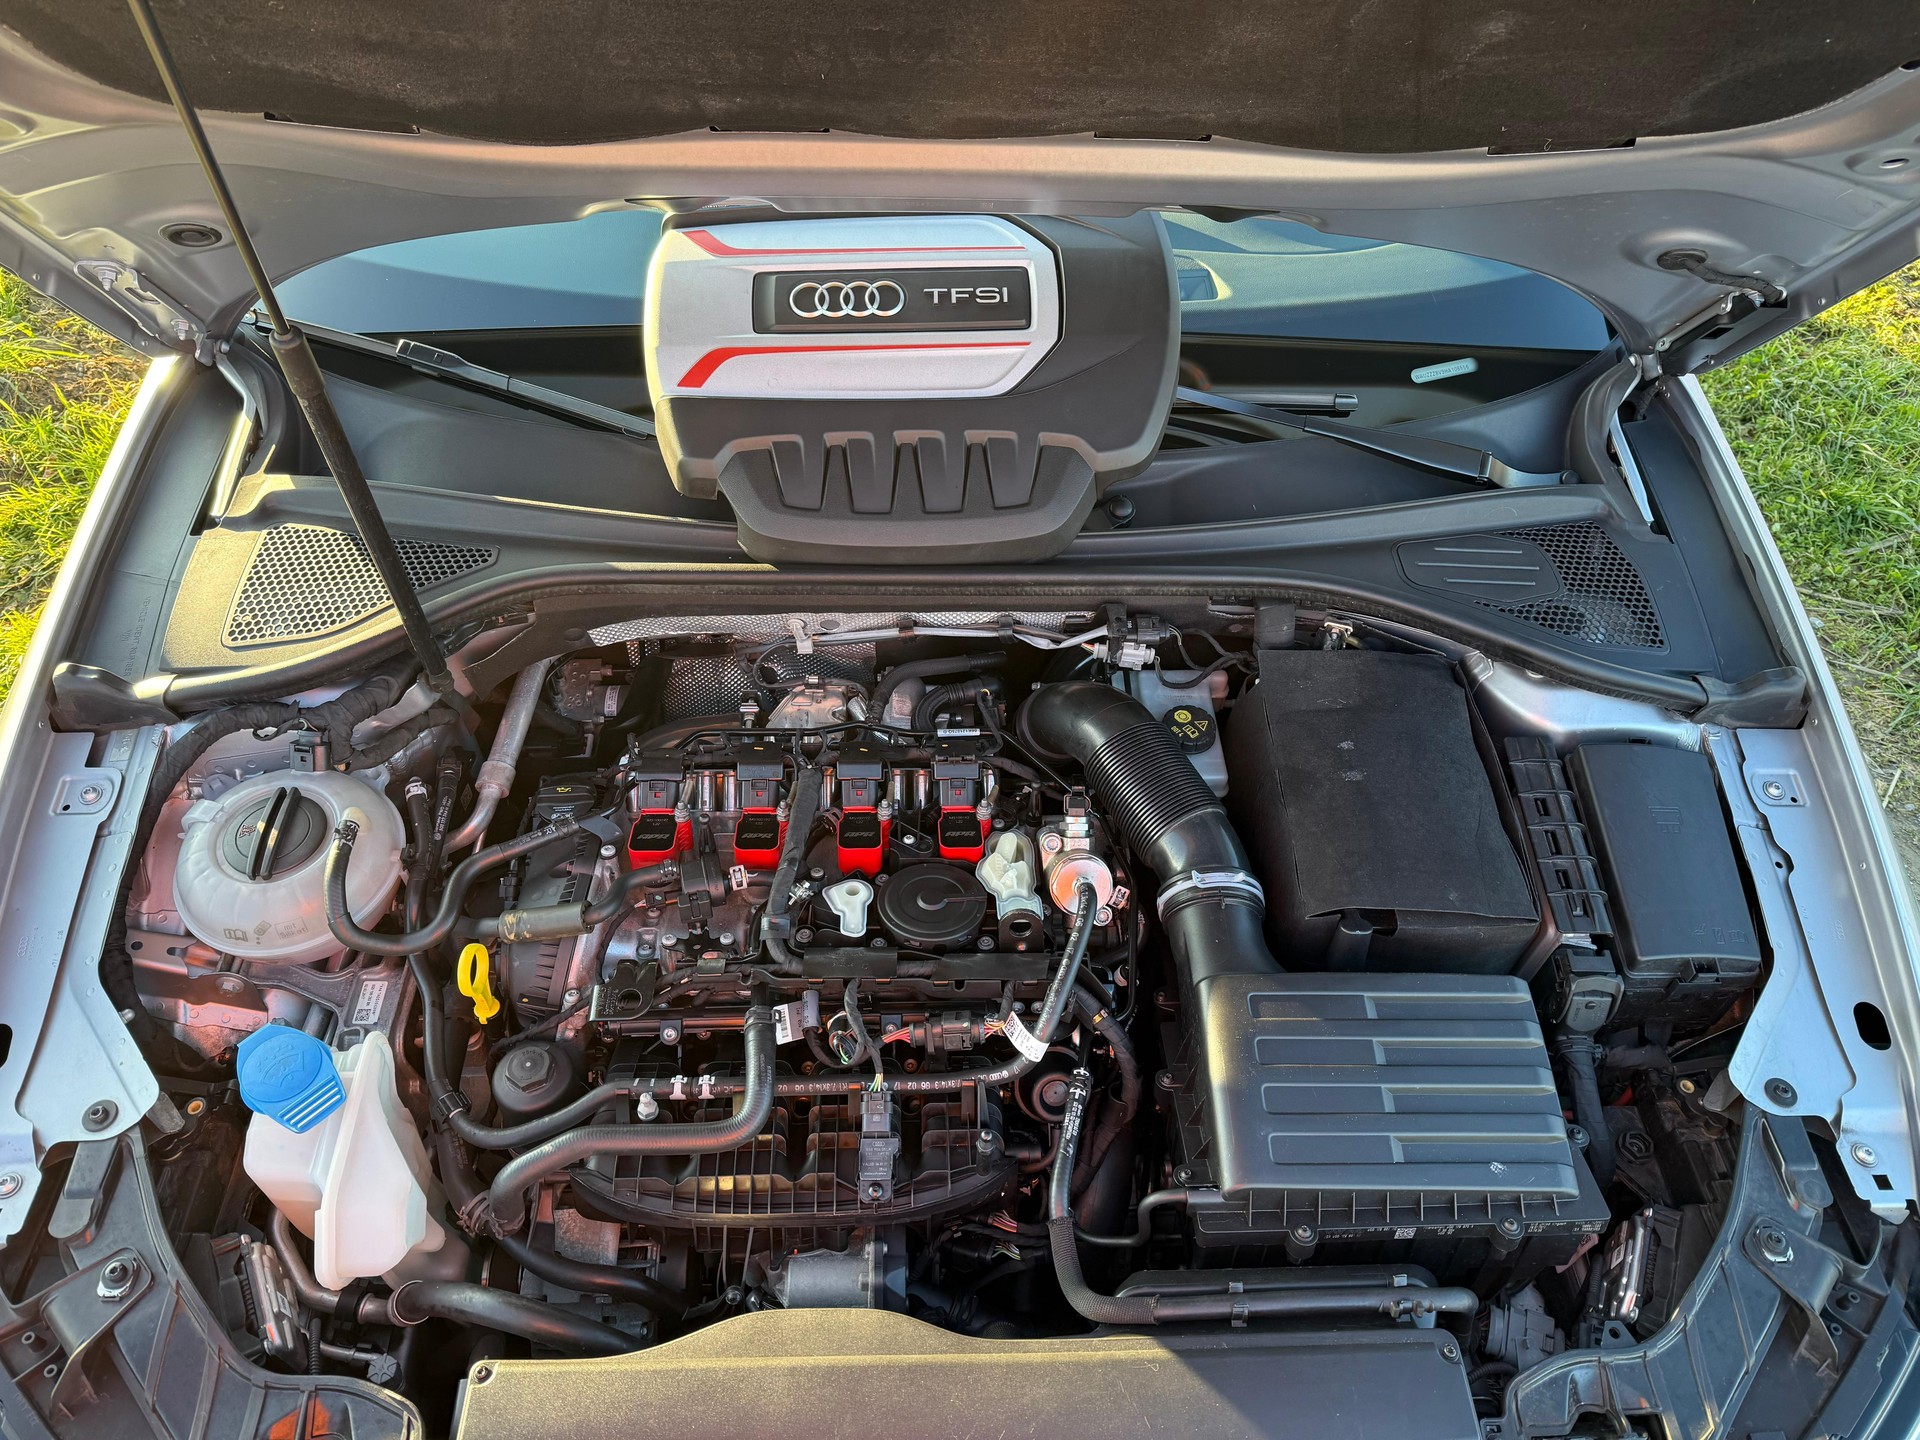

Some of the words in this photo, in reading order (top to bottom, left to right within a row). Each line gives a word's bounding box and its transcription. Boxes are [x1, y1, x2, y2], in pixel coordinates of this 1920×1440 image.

[922, 286, 1009, 305] TFSI
[1070, 931, 1080, 941] 02
[907, 1081, 917, 1089] 02
